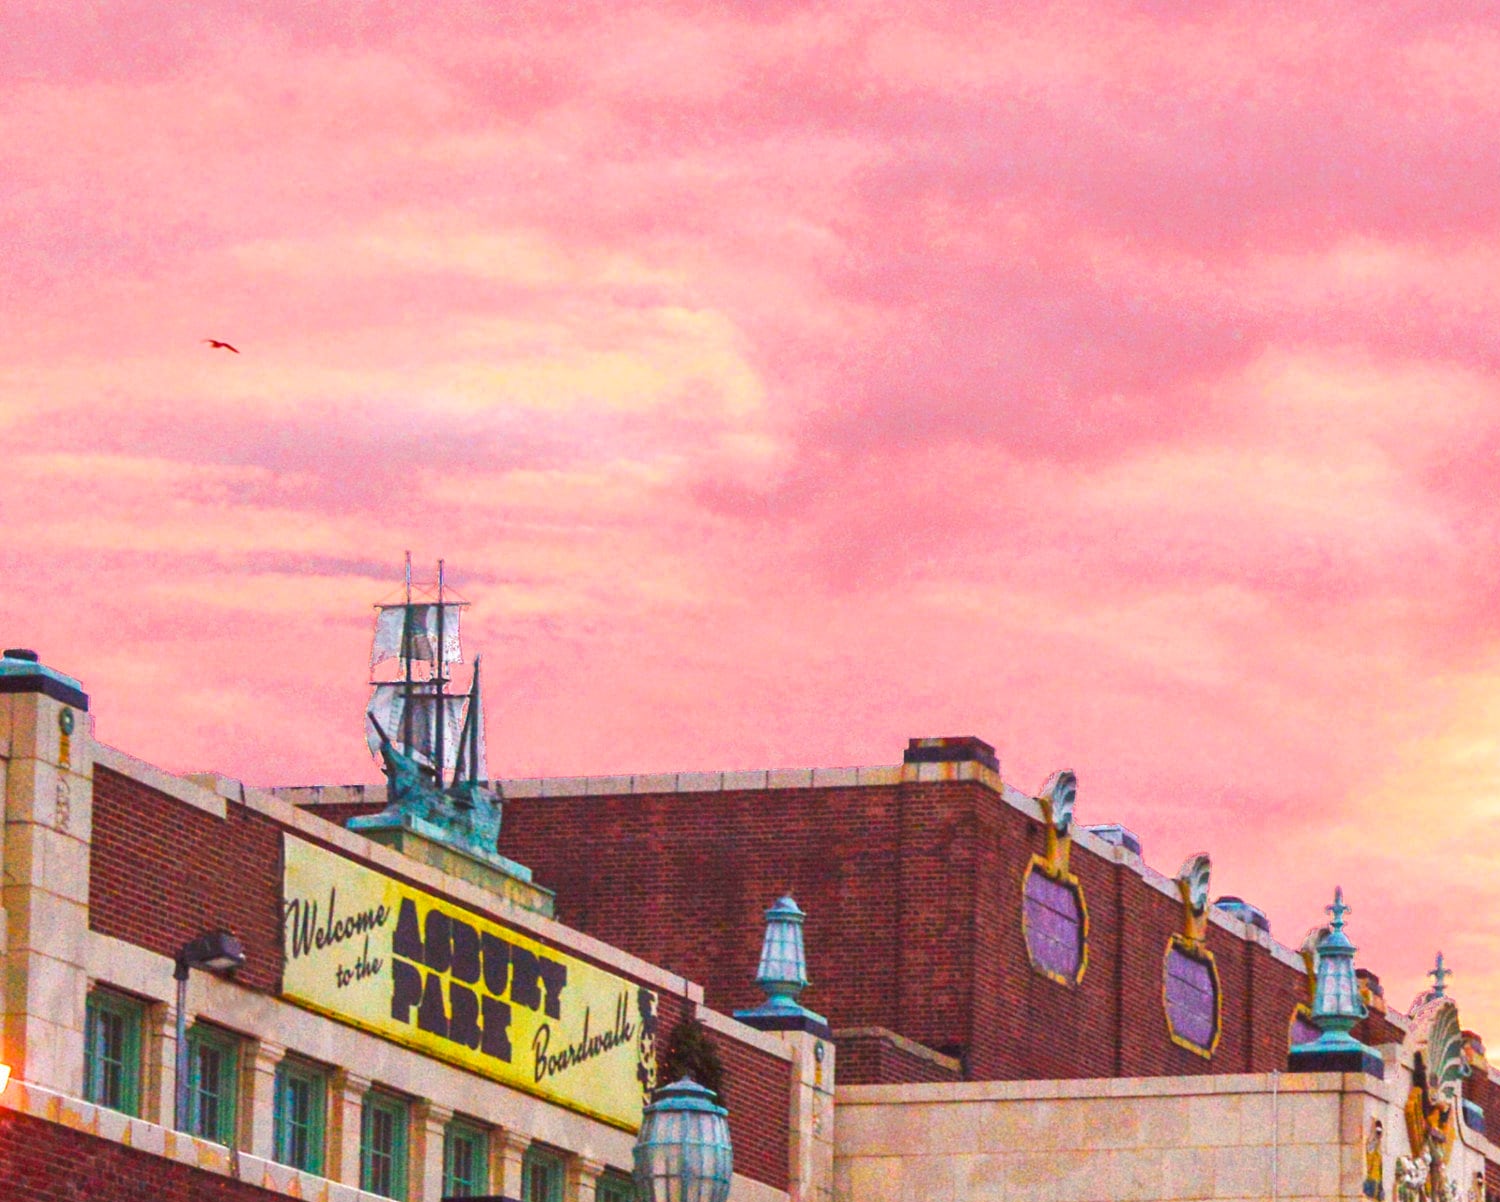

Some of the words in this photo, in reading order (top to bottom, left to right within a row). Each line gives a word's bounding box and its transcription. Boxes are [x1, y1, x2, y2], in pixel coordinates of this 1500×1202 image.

[285, 886, 391, 958] Welcome
[336, 964, 354, 988] to
[355, 934, 383, 981] the
[532, 990, 635, 1083] Boardwalk
